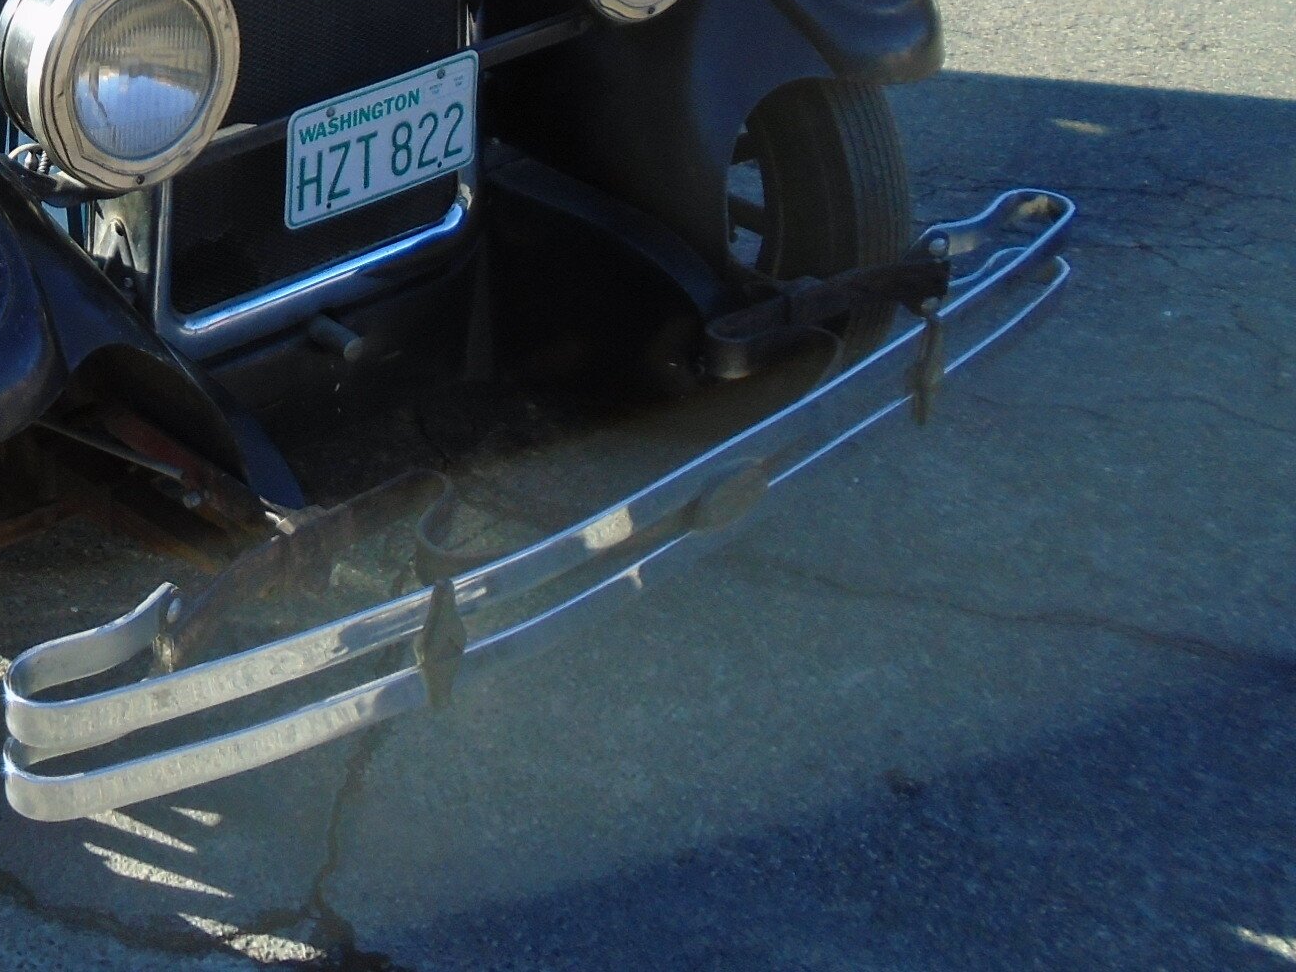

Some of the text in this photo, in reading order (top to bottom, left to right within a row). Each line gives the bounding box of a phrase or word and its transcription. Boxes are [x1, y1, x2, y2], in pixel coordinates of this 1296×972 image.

[297, 101, 464, 212] HZT 822
[298, 88, 420, 145] WASHINGTON
